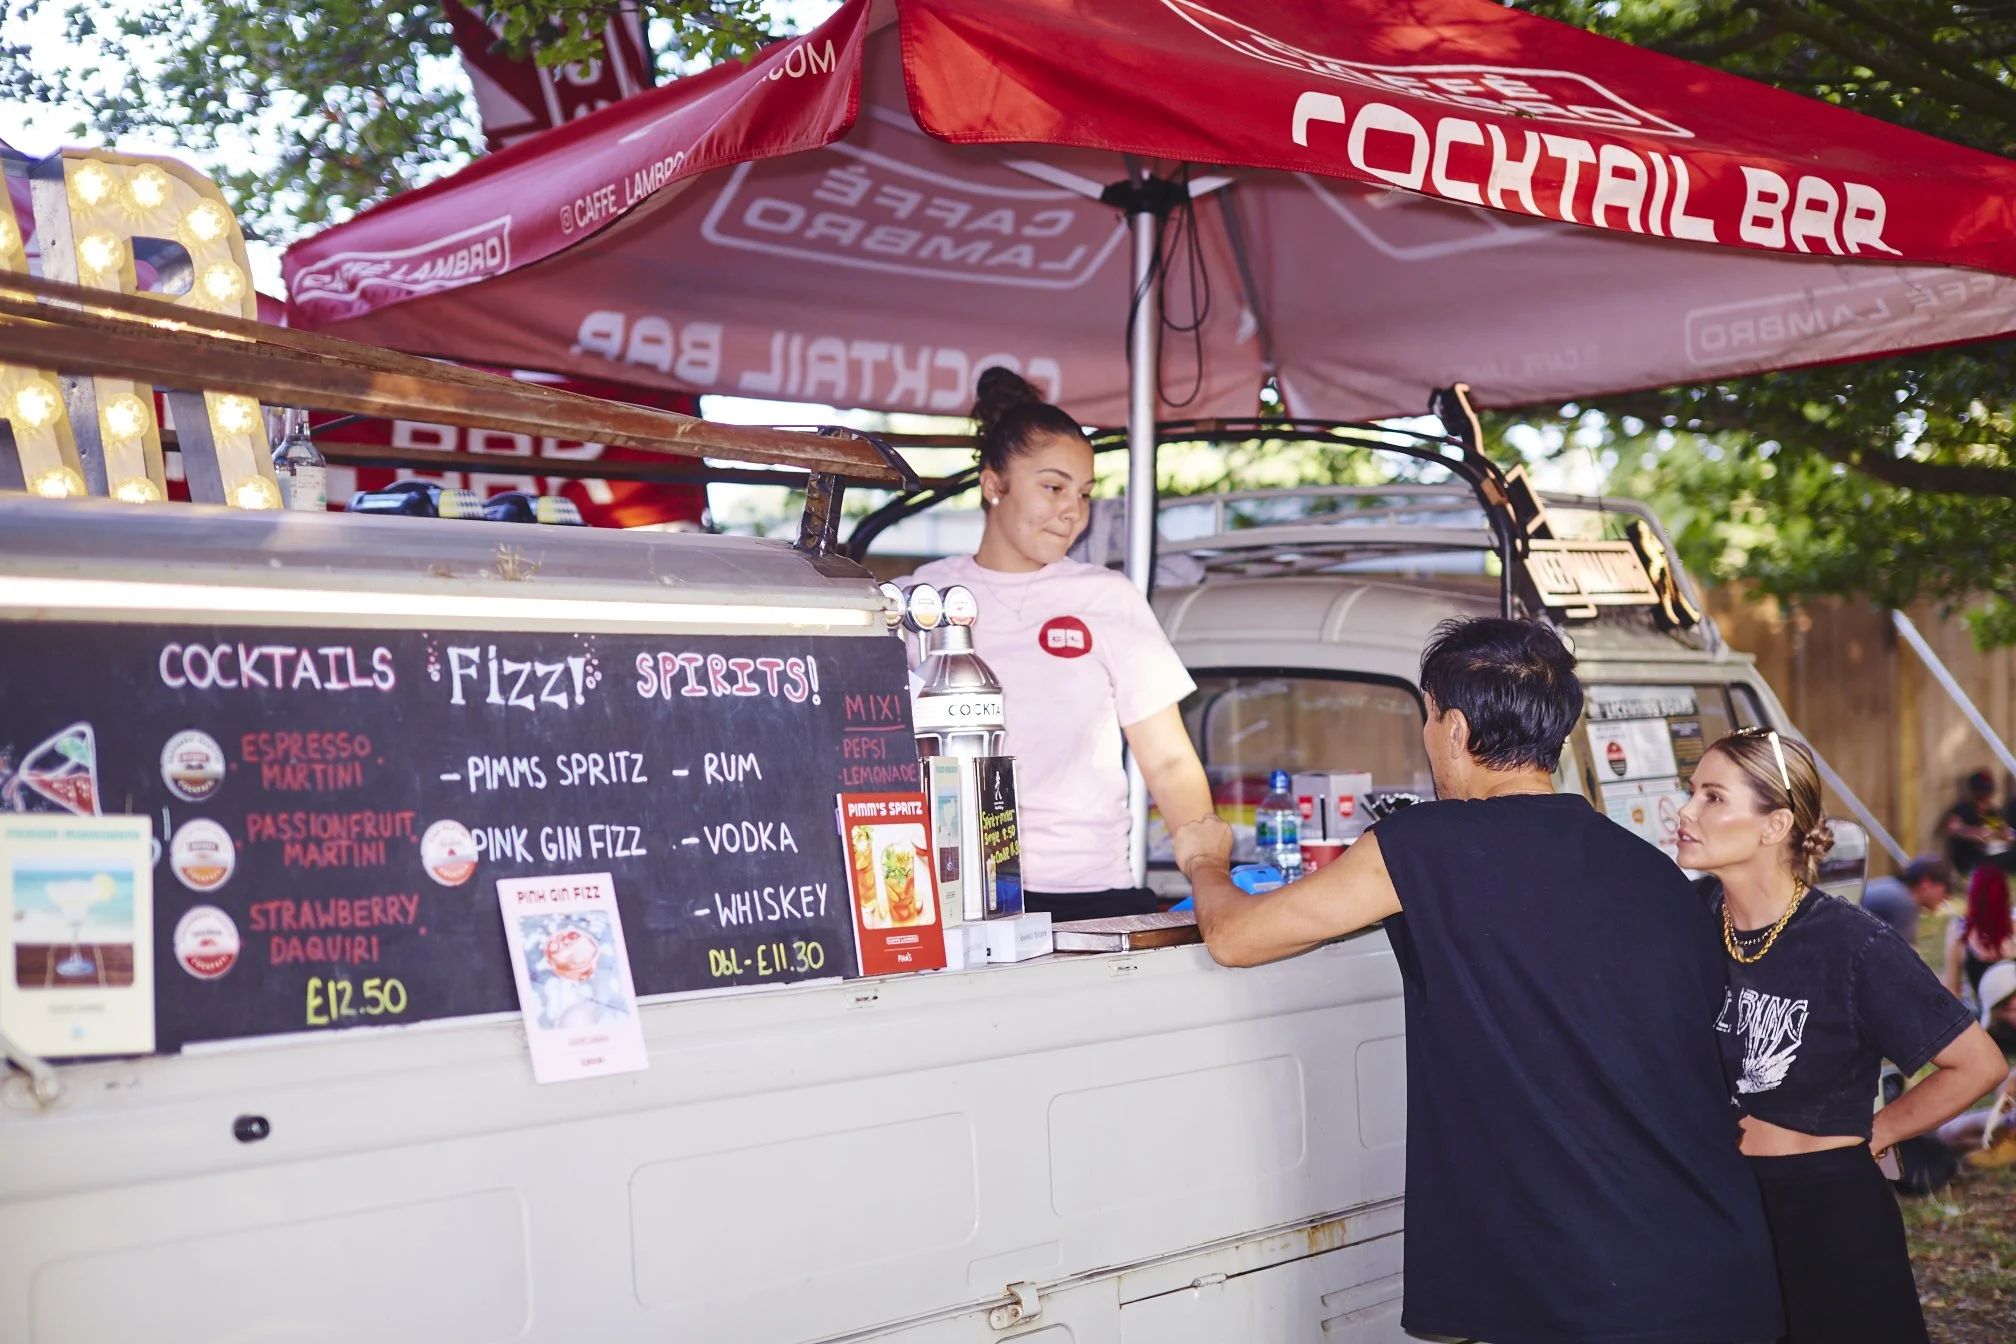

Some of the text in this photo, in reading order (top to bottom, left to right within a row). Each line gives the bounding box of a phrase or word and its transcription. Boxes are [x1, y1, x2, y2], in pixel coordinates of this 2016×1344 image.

[1291, 91, 1903, 257] COCKTAIL BAR
[389, 236, 500, 281] LAMBRO
[160, 642, 396, 691] COCKTAILS
[635, 652, 821, 706] SPIRITS!
[845, 693, 902, 722] MIX!
[240, 731, 372, 765] ESPRESSO
[843, 736, 886, 759] PEPSI
[261, 761, 363, 792] MARTINI
[467, 751, 648, 793] PIMMS SPRITZ
[704, 752, 762, 784] RUM
[842, 760, 918, 784] LEMONADE
[246, 810, 416, 842] PASSIONFRUIT
[848, 801, 923, 817] PIMM'S SPRITZ
[283, 839, 387, 870] MARTINI
[471, 824, 534, 863] PINK
[540, 825, 582, 862] GIN
[588, 823, 647, 859] FIZZ
[704, 821, 798, 855] VODKA
[517, 885, 601, 904] PINK GIN FIZZ
[714, 883, 828, 928] WHISKEY
[249, 894, 420, 933] STRAWBERRY
[270, 935, 379, 967] DAQUIRI
[306, 977, 408, 1026] £12.50
